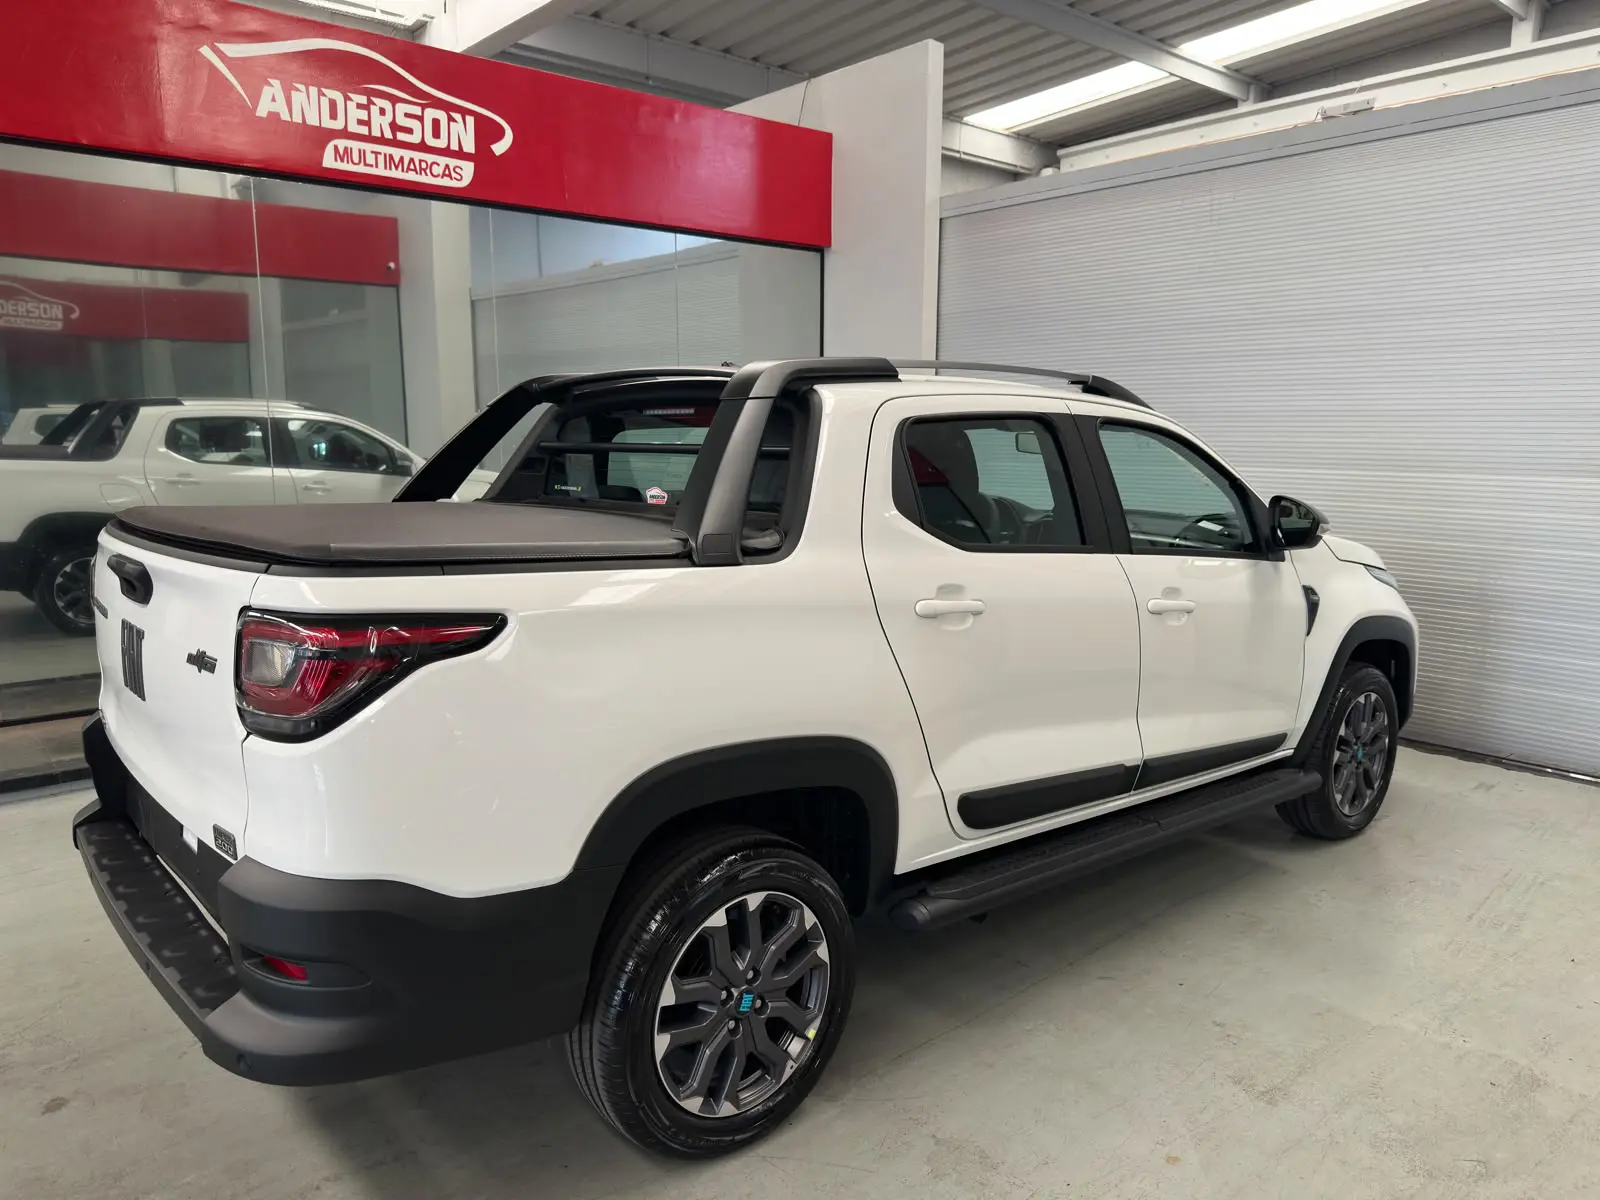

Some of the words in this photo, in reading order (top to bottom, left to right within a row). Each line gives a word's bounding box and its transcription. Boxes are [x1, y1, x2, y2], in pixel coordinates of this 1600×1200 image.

[255, 78, 475, 153] ANDERSON
[333, 143, 464, 182] MULTIMARCAS
[215, 837, 233, 855] 200
[740, 993, 755, 1012] FIAT
